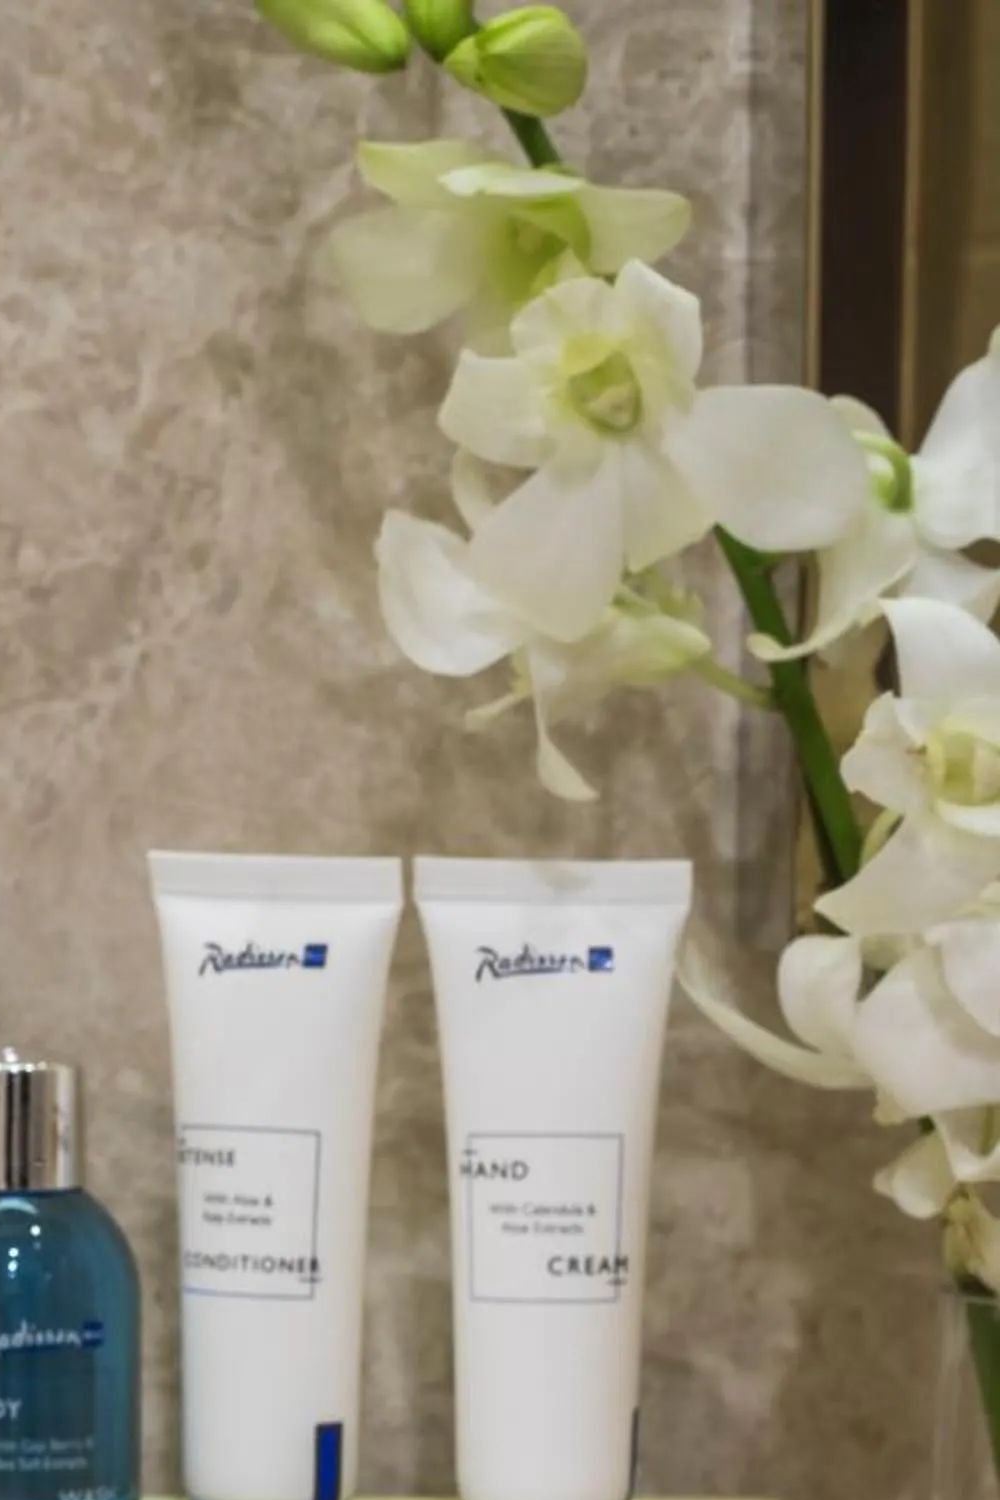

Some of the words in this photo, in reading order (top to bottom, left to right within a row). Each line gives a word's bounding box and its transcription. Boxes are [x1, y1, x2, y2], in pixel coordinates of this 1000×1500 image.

[198, 940, 300, 977] Radisson
[475, 942, 586, 983] Radisson
[458, 1159, 531, 1181] HAND
[546, 1255, 629, 1277] CREAM
